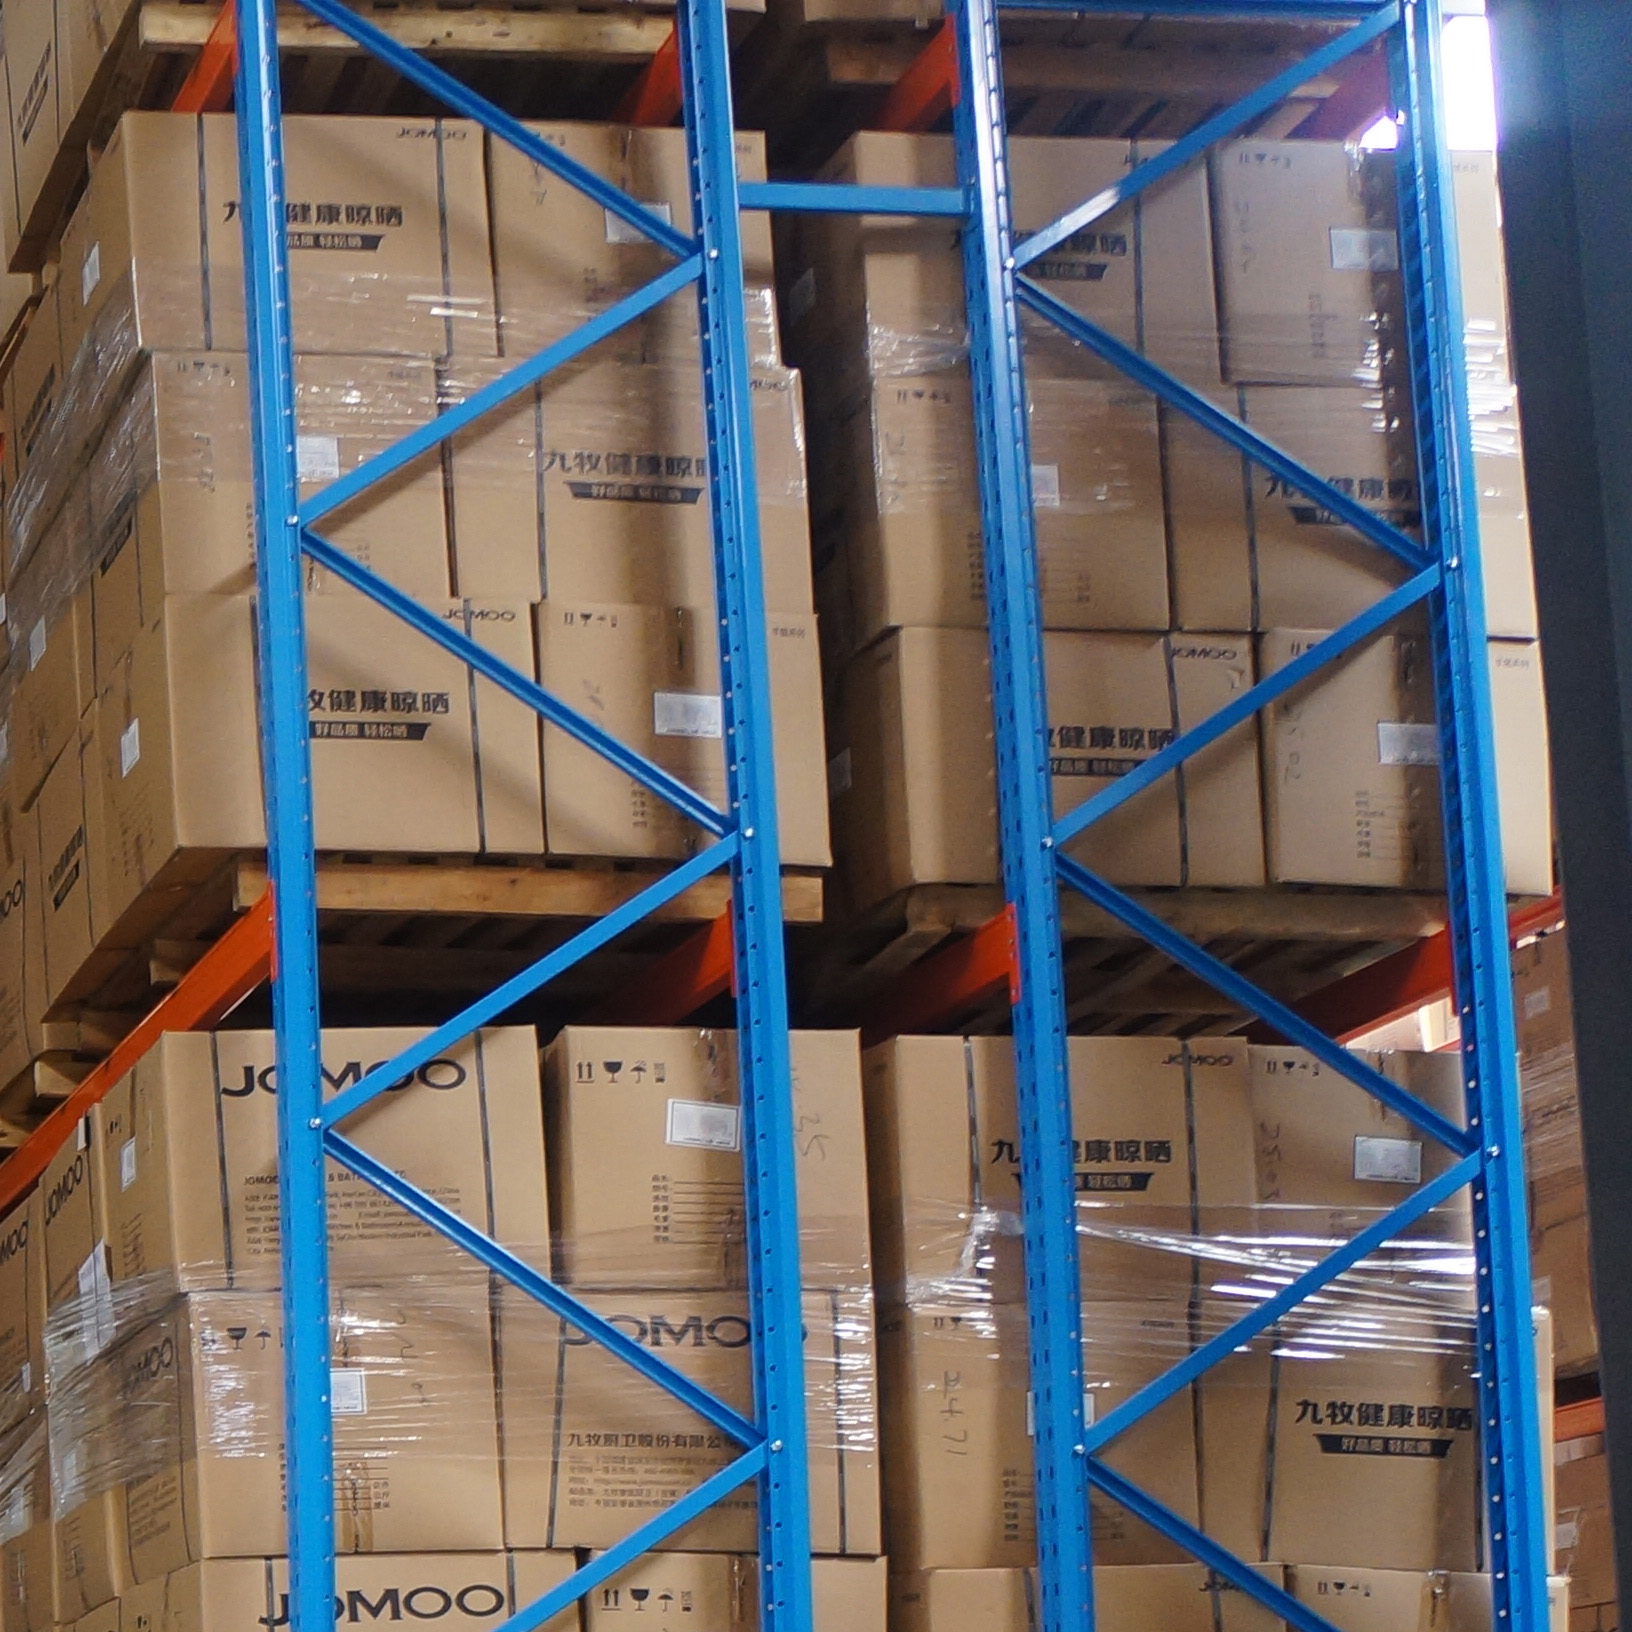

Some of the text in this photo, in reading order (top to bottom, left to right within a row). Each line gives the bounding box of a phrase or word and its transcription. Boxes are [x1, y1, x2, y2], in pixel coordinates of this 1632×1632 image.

[991, 1140, 1172, 1164] 九康晾晒
[258, 1585, 505, 1626] JMOO
